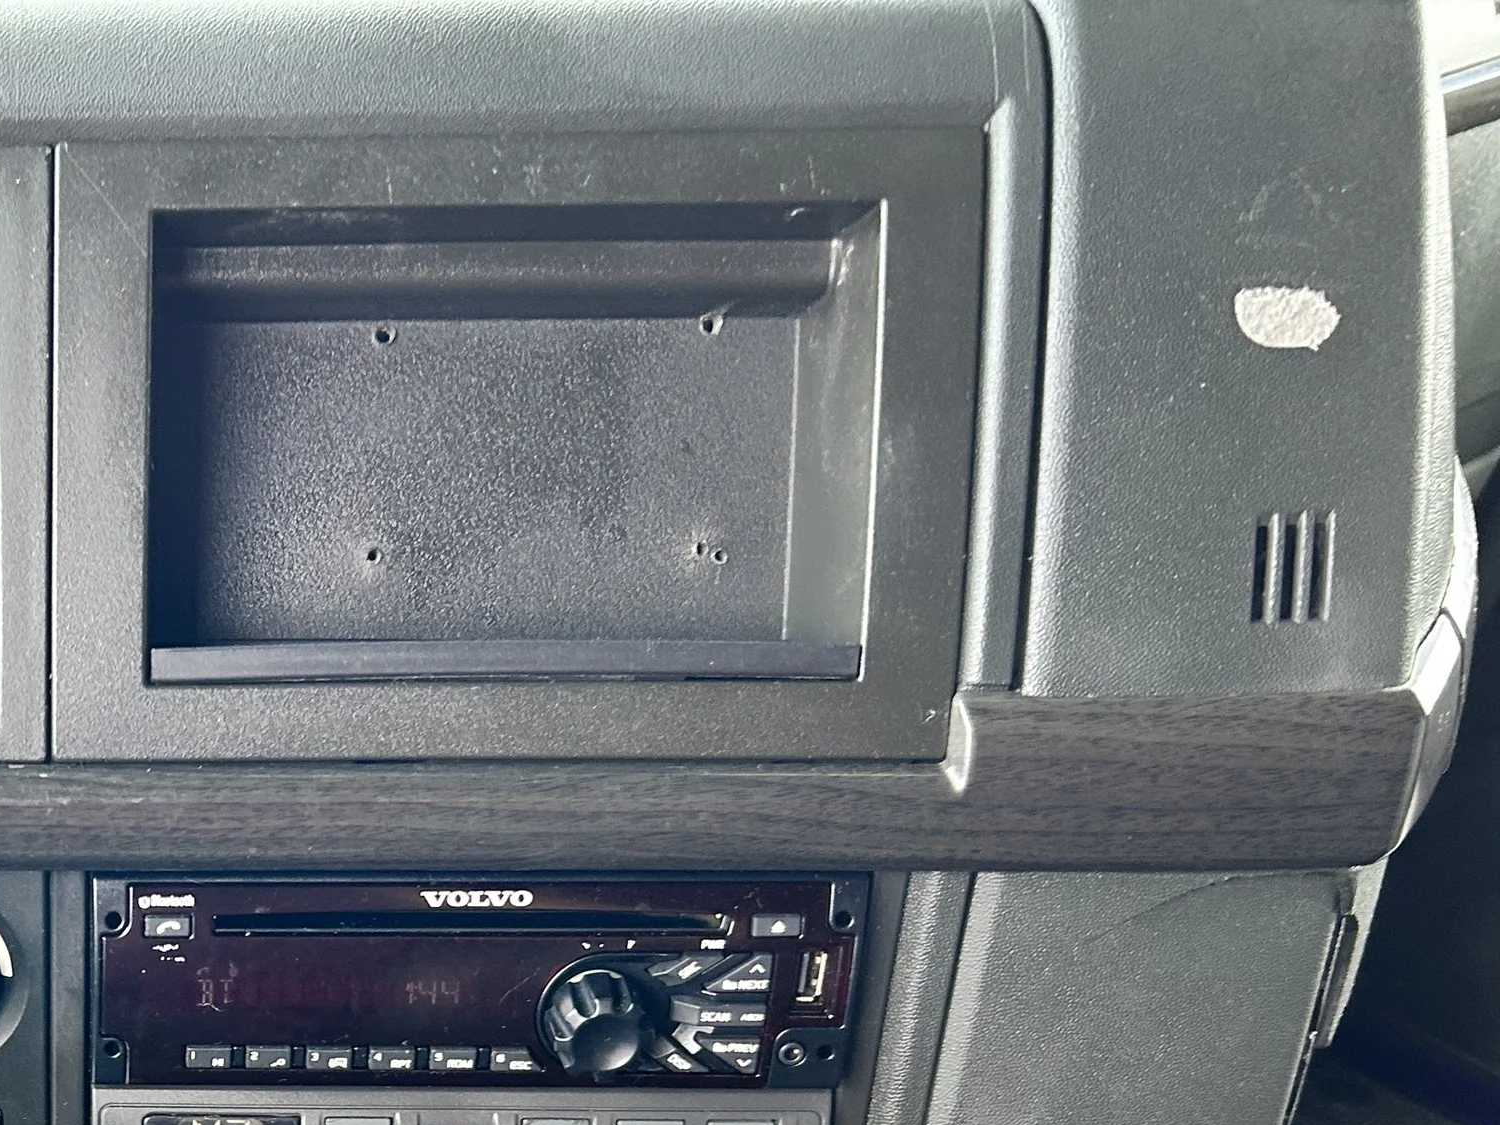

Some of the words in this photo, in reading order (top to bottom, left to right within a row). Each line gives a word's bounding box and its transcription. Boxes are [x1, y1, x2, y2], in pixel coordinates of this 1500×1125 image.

[420, 890, 534, 908] VOLVO
[249, 1051, 259, 1061] 2
[310, 1052, 320, 1062] 3
